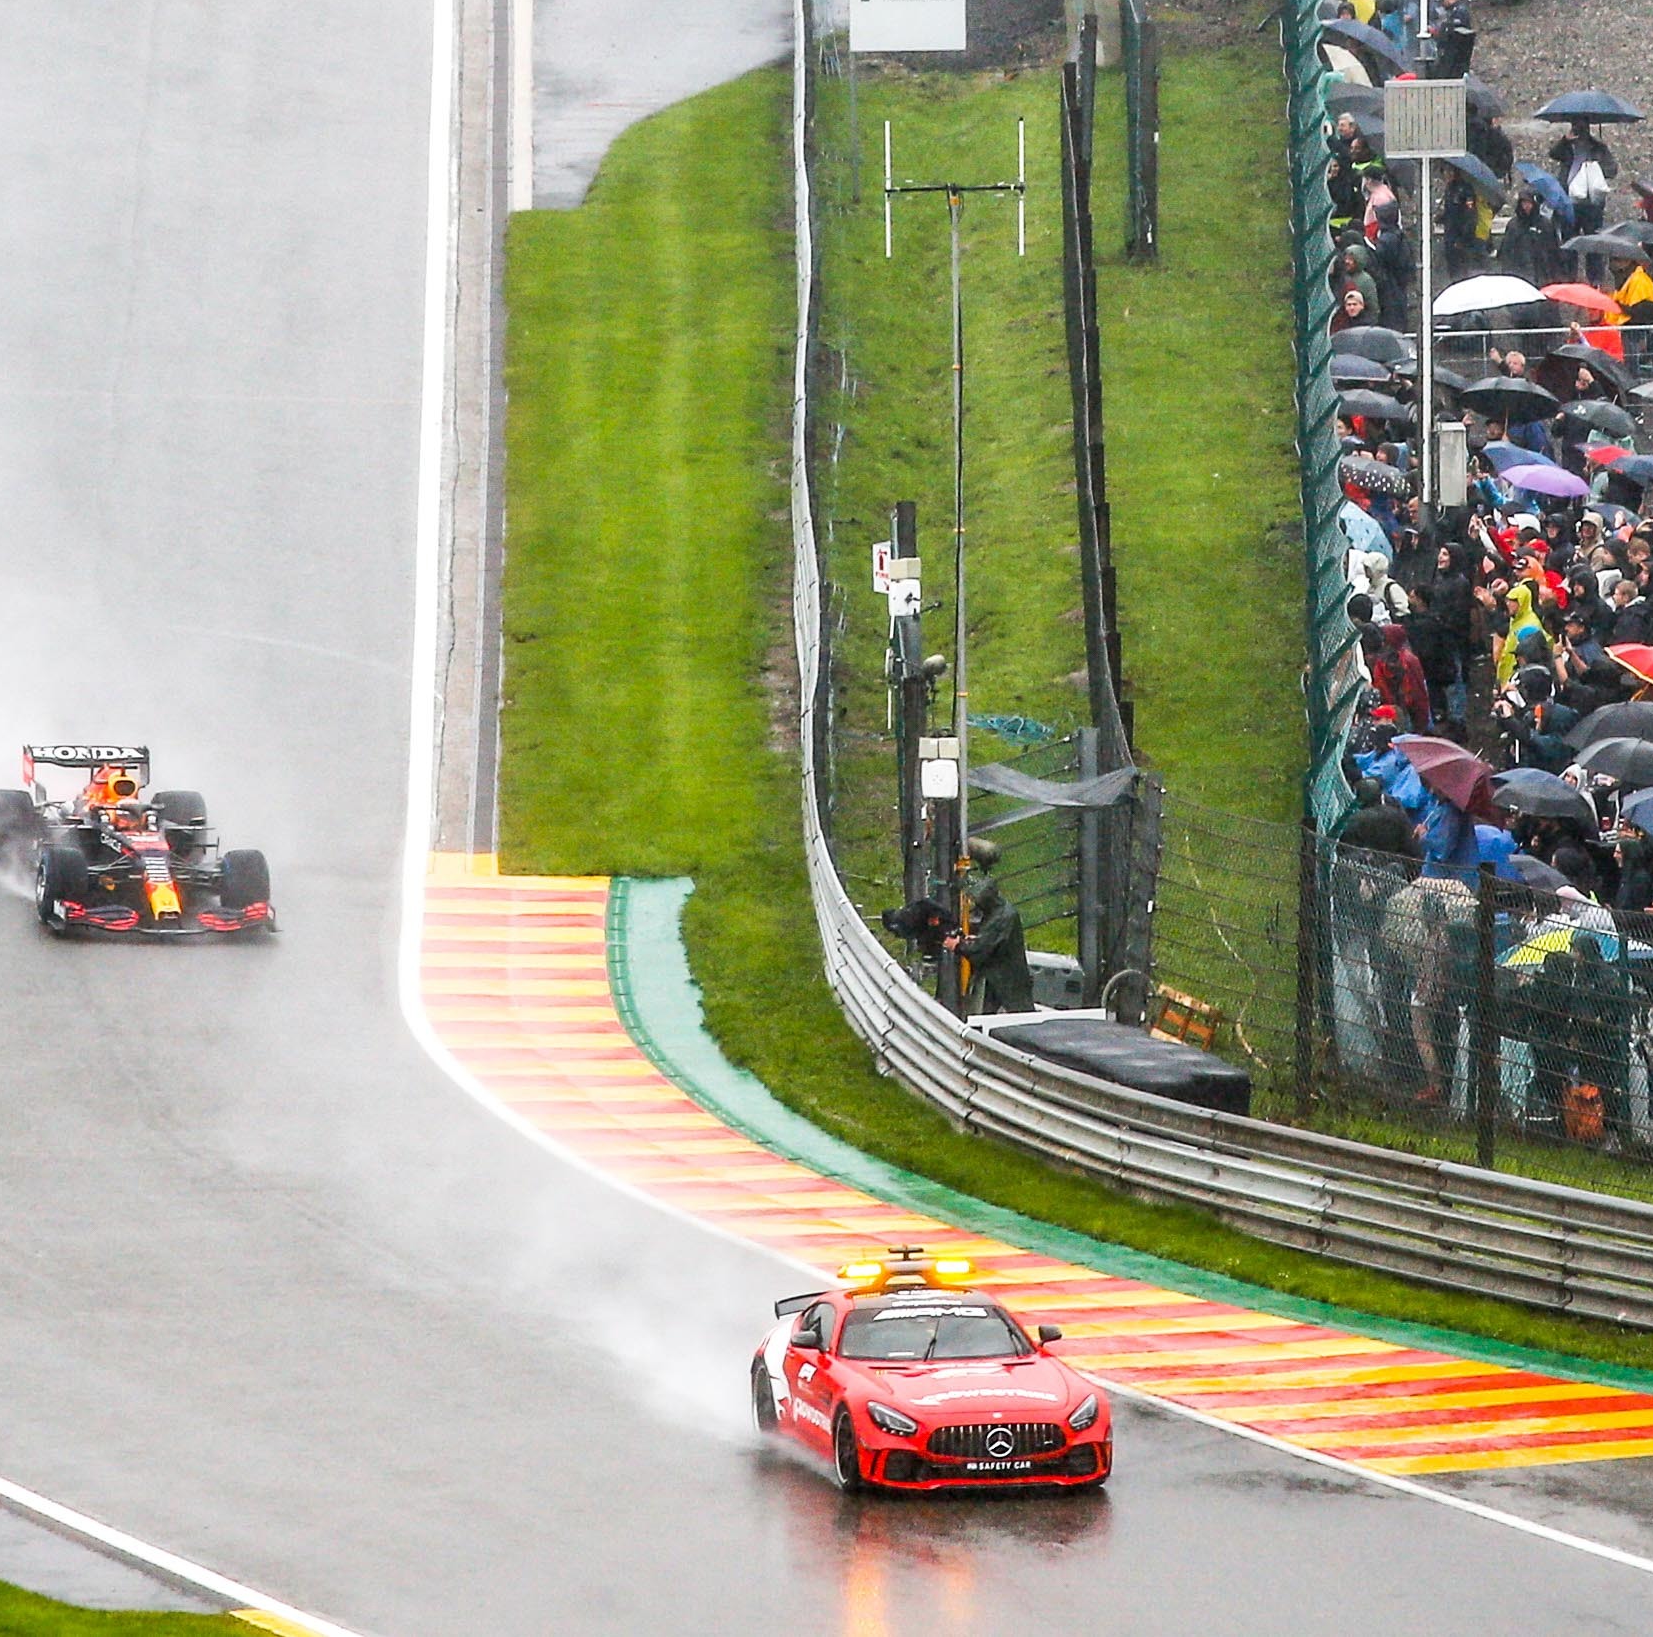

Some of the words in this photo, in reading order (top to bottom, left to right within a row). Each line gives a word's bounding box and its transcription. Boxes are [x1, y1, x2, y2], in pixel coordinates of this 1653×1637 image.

[32, 746, 145, 760] HONDA
[978, 1461, 1012, 1471] SAFETY
[1014, 1460, 1032, 1470] CAR
